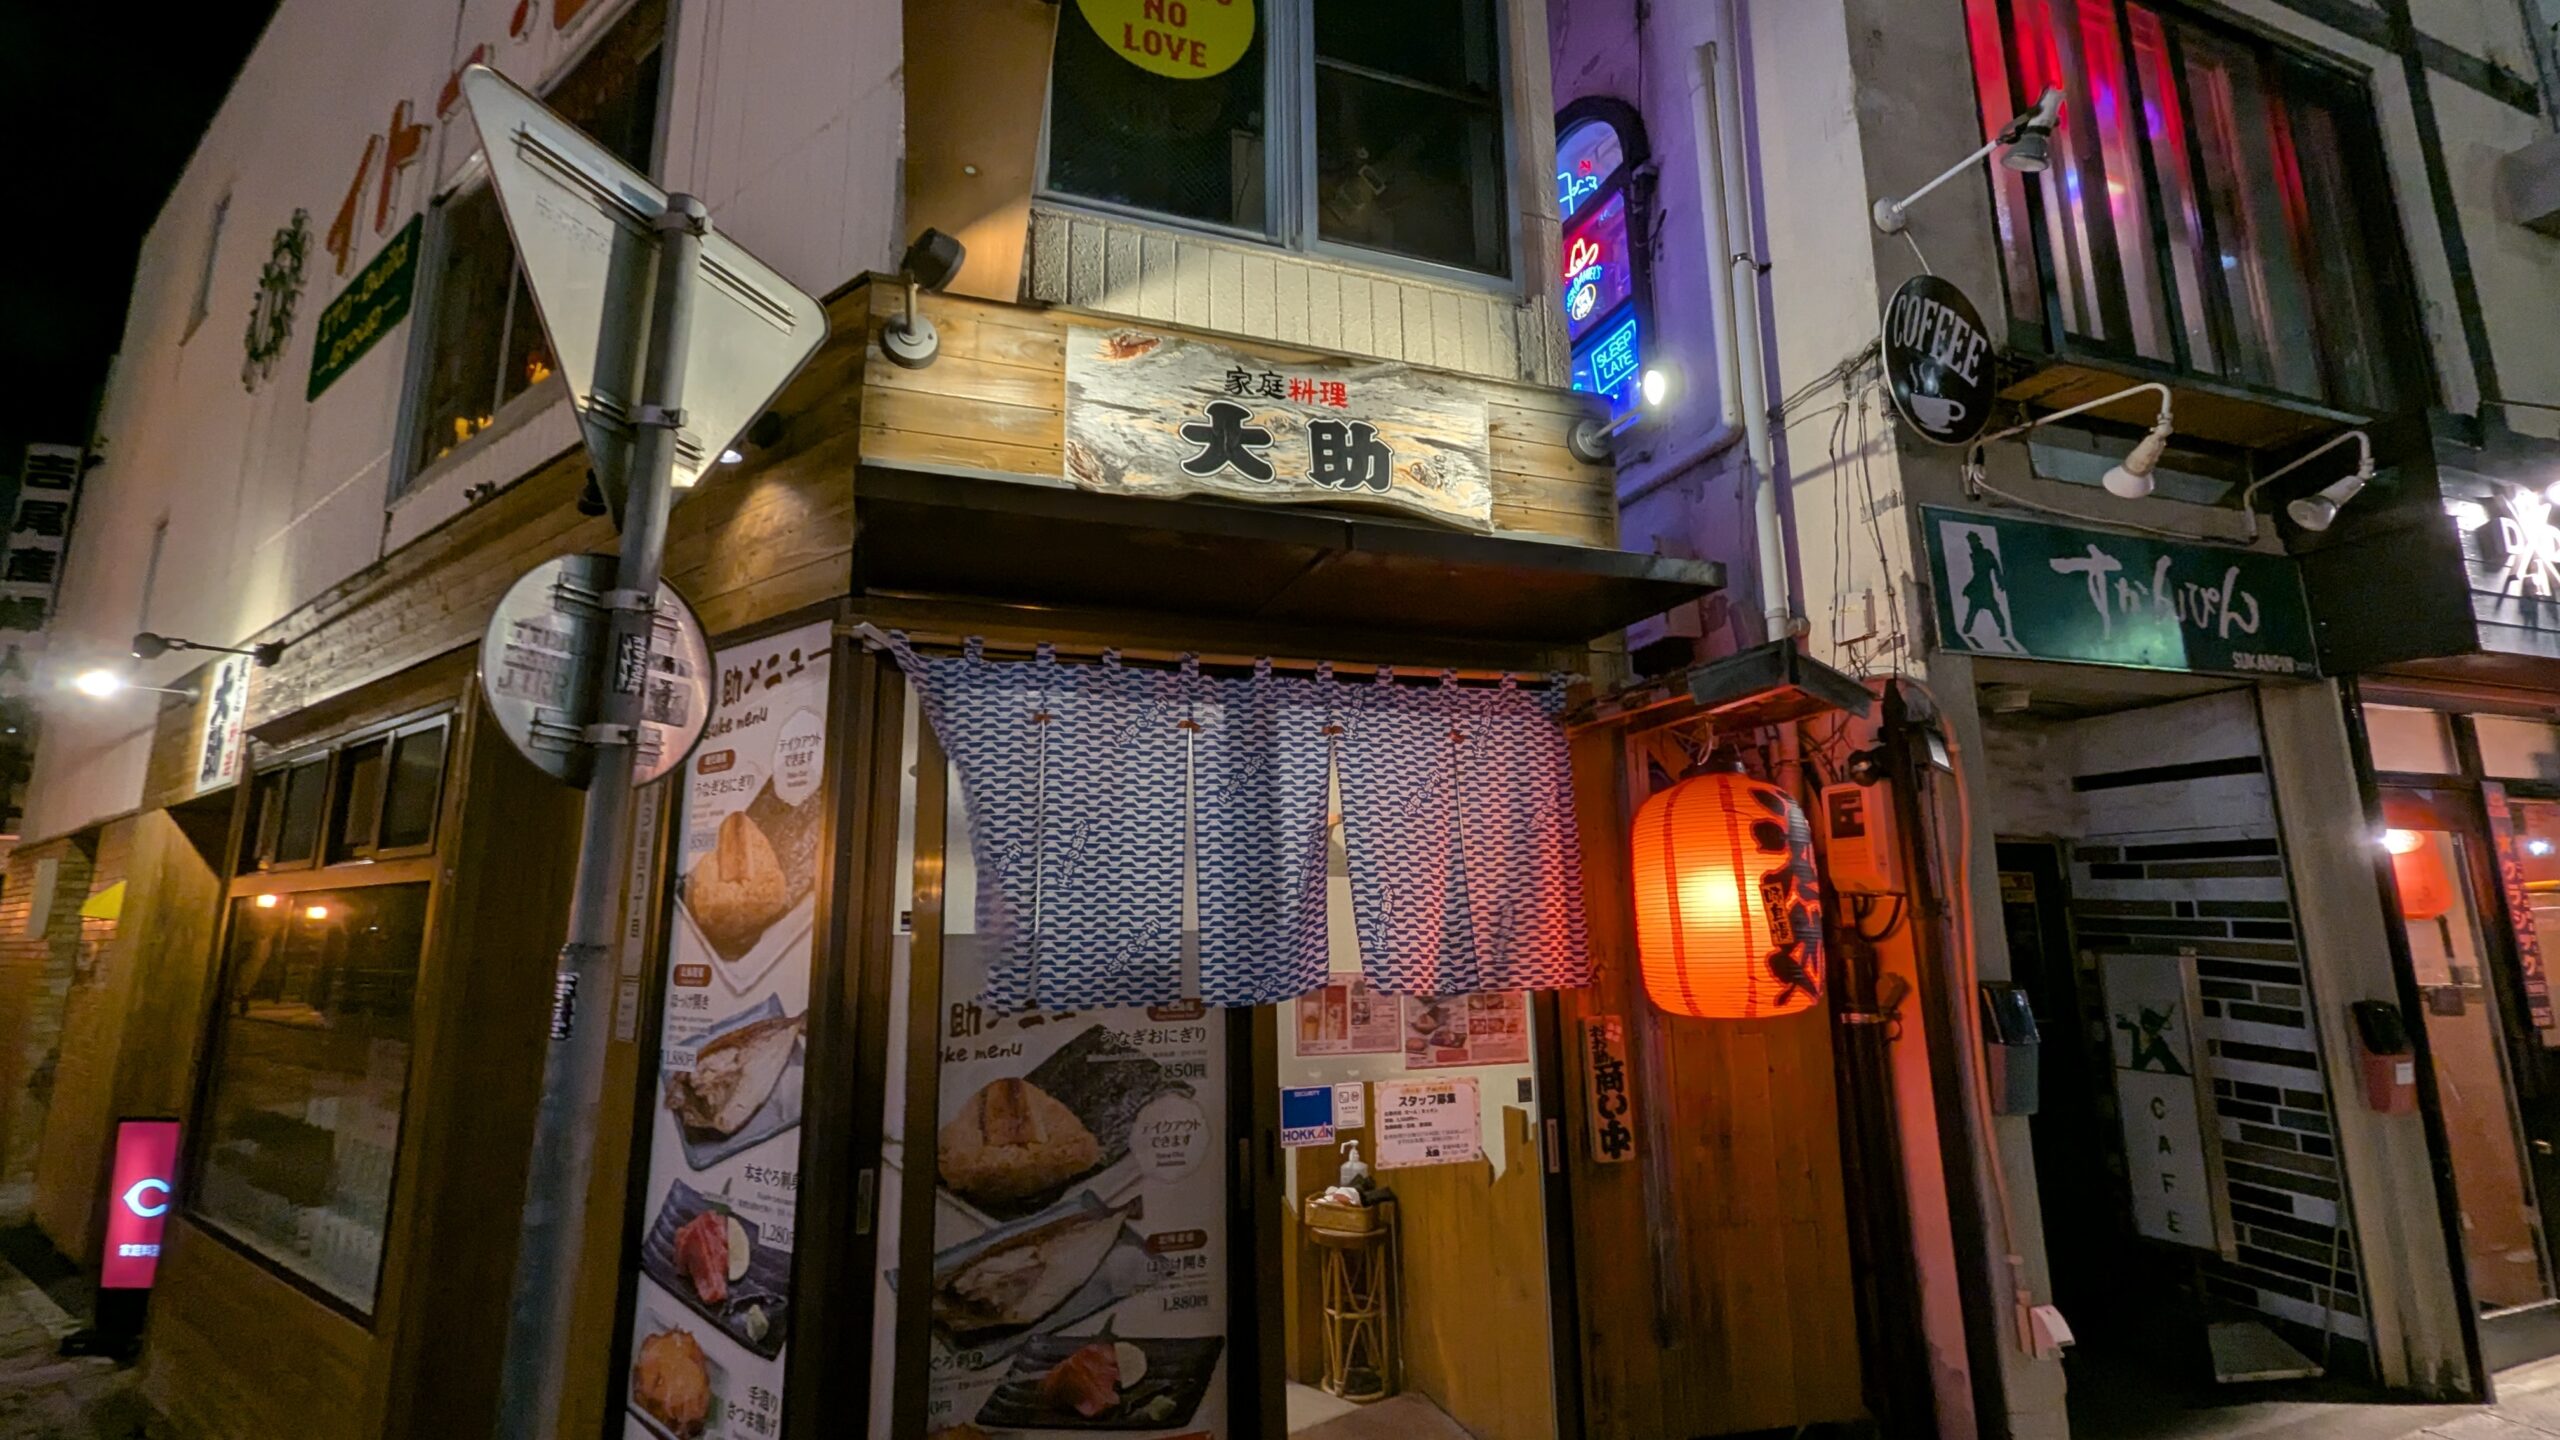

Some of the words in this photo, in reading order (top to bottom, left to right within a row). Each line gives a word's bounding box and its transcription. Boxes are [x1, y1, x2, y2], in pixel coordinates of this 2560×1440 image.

[1143, 0, 1187, 28] NO
[1123, 22, 1208, 69] LOVE
[1596, 329, 1632, 369] SLEEP
[1893, 294, 1988, 389] COFFEE
[1603, 349, 1634, 380] LATE
[1223, 364, 1350, 410] 家庭料理
[1179, 400, 1395, 494] 大助
[2049, 542, 2260, 642] すかんぴん
[736, 706, 768, 729] menu
[974, 1041, 1023, 1059] menu
[1101, 1026, 1207, 1047] うなぎおにぎり
[1163, 1062, 1207, 1079] 850円
[1398, 1092, 1457, 1108] スタッフ募集
[1141, 1117, 1201, 1136] テイクアウト
[1282, 1124, 1334, 1142] HOKKAN
[1150, 1133, 1192, 1149] できます
[2150, 1096, 2183, 1235] CAFE
